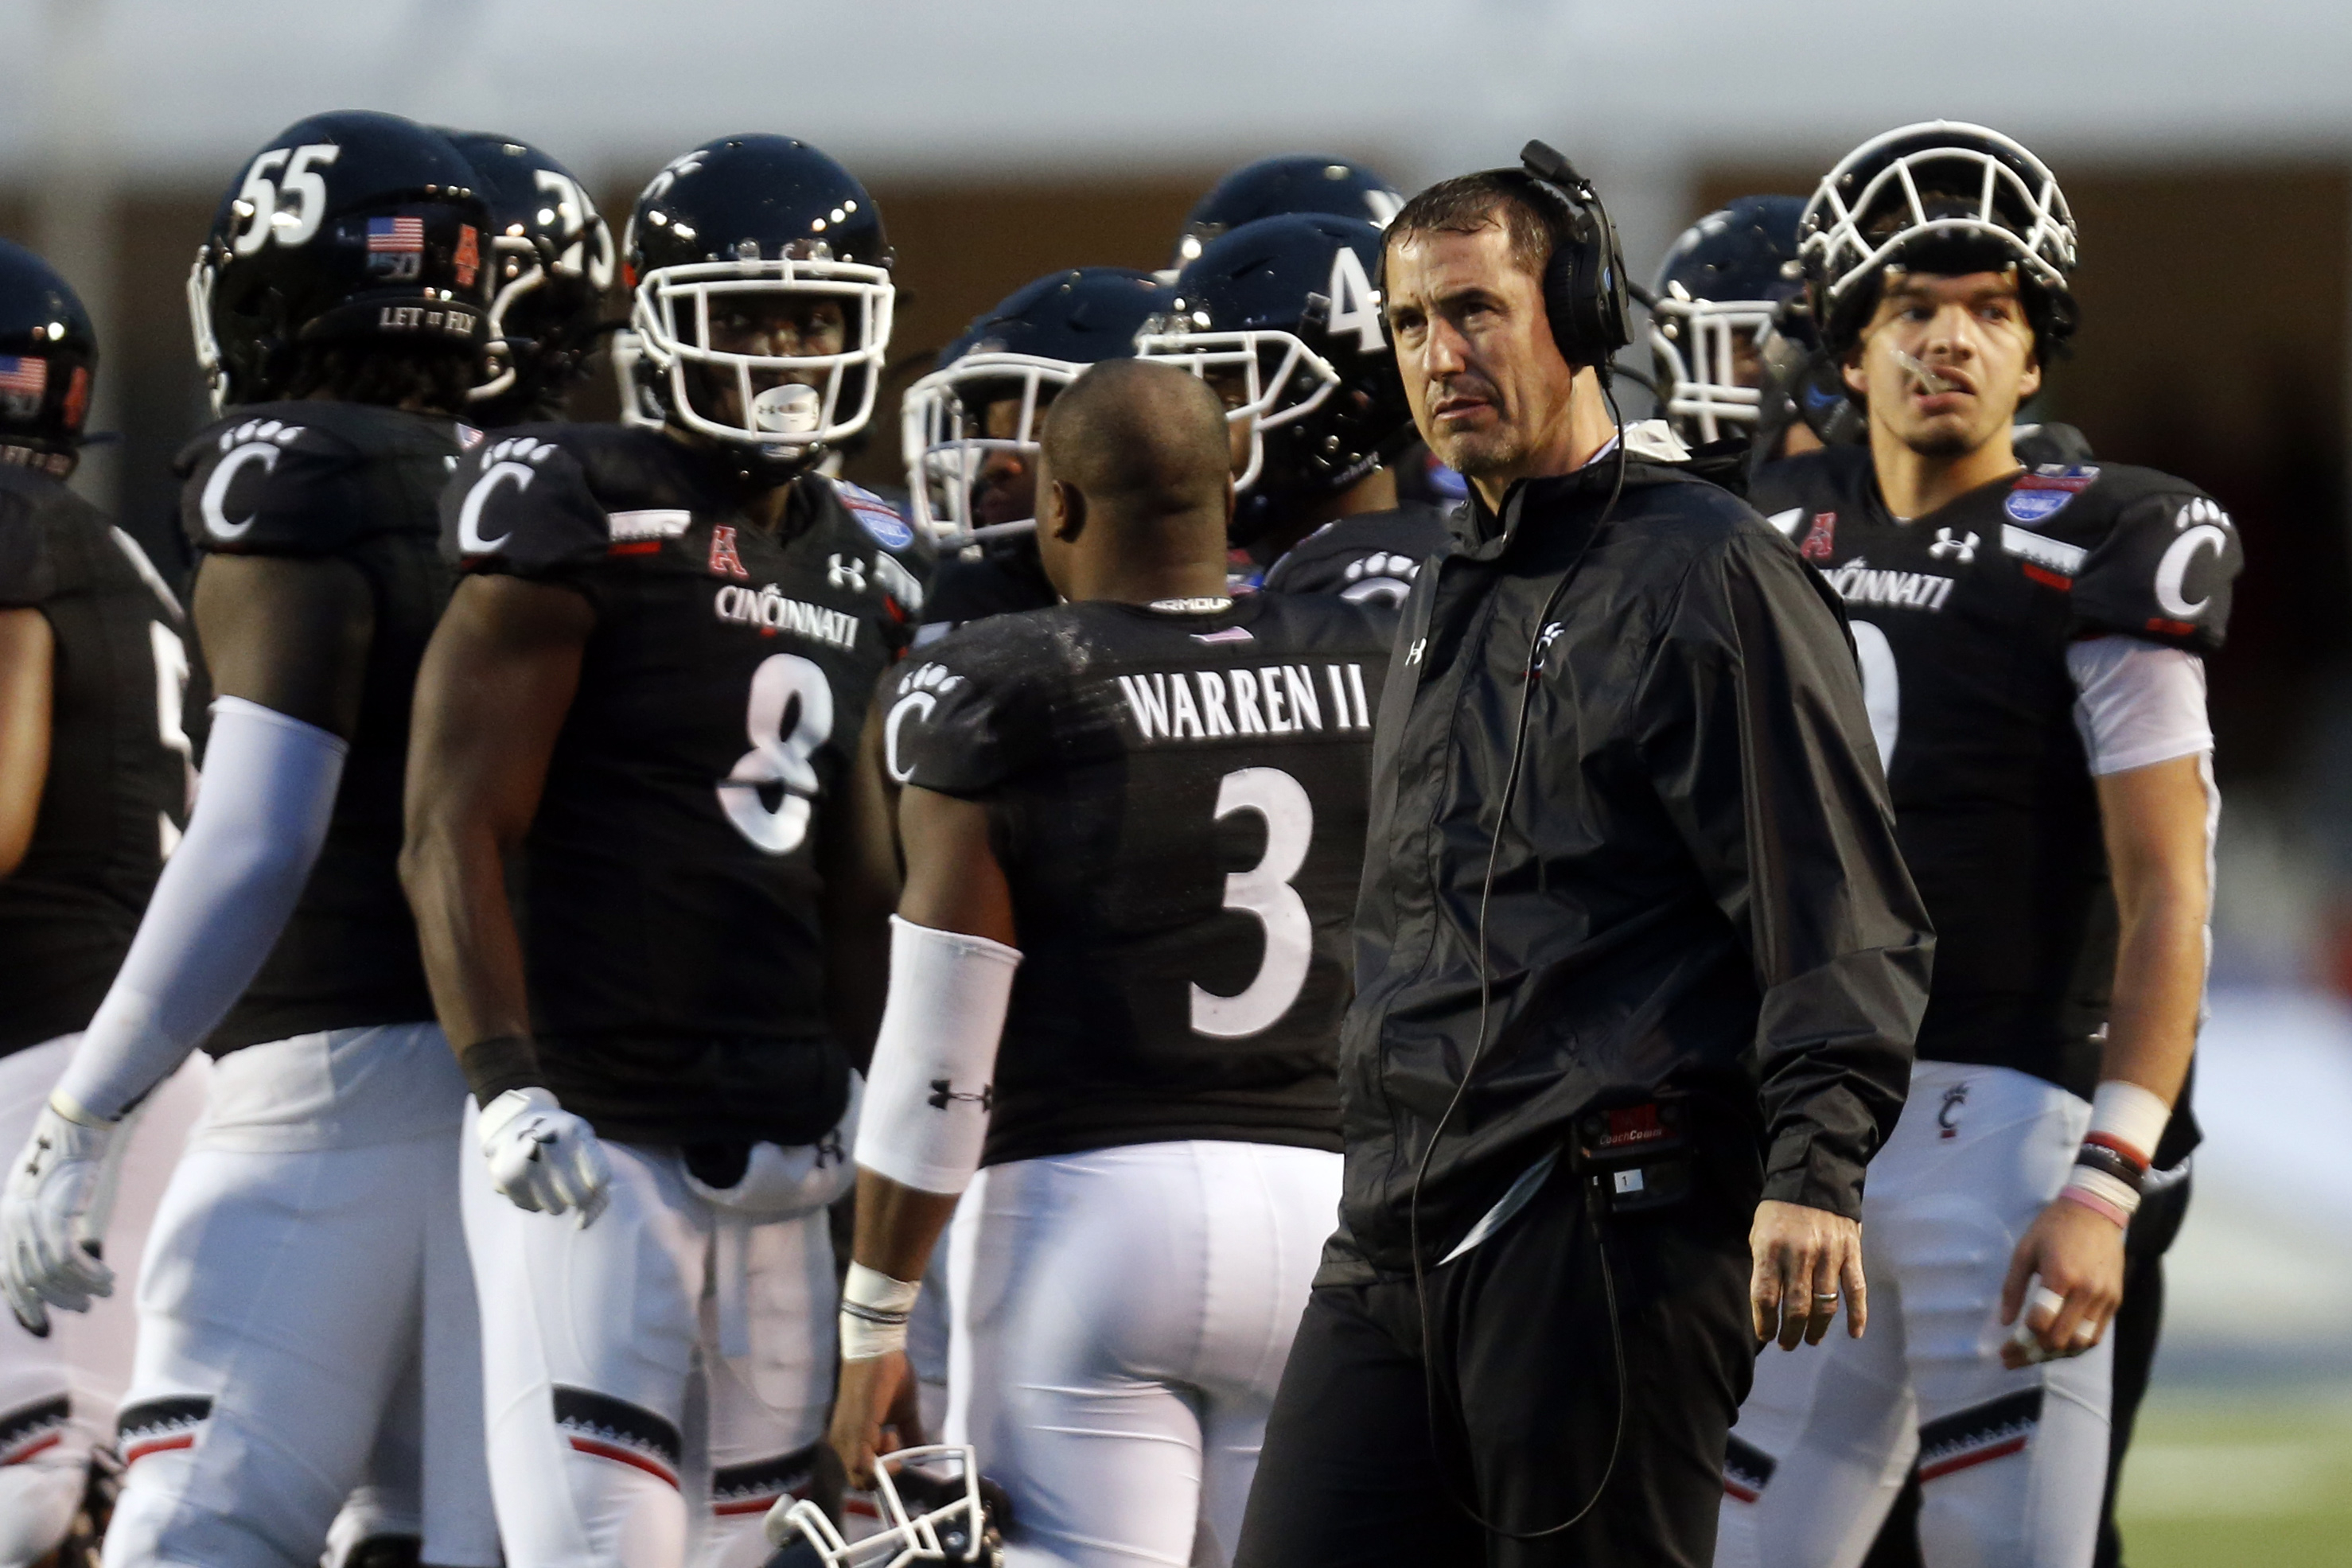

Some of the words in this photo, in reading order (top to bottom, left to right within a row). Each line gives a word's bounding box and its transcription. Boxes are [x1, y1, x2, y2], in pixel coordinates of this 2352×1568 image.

[234, 145, 340, 255] 55
[380, 307, 425, 326] LET
[1328, 247, 1388, 352] 4
[716, 584, 859, 650] CINCINNATI
[717, 652, 834, 855] 8
[1119, 664, 1322, 739] WARREN
[1327, 663, 1370, 729] II
[1190, 766, 1314, 1039] 3
